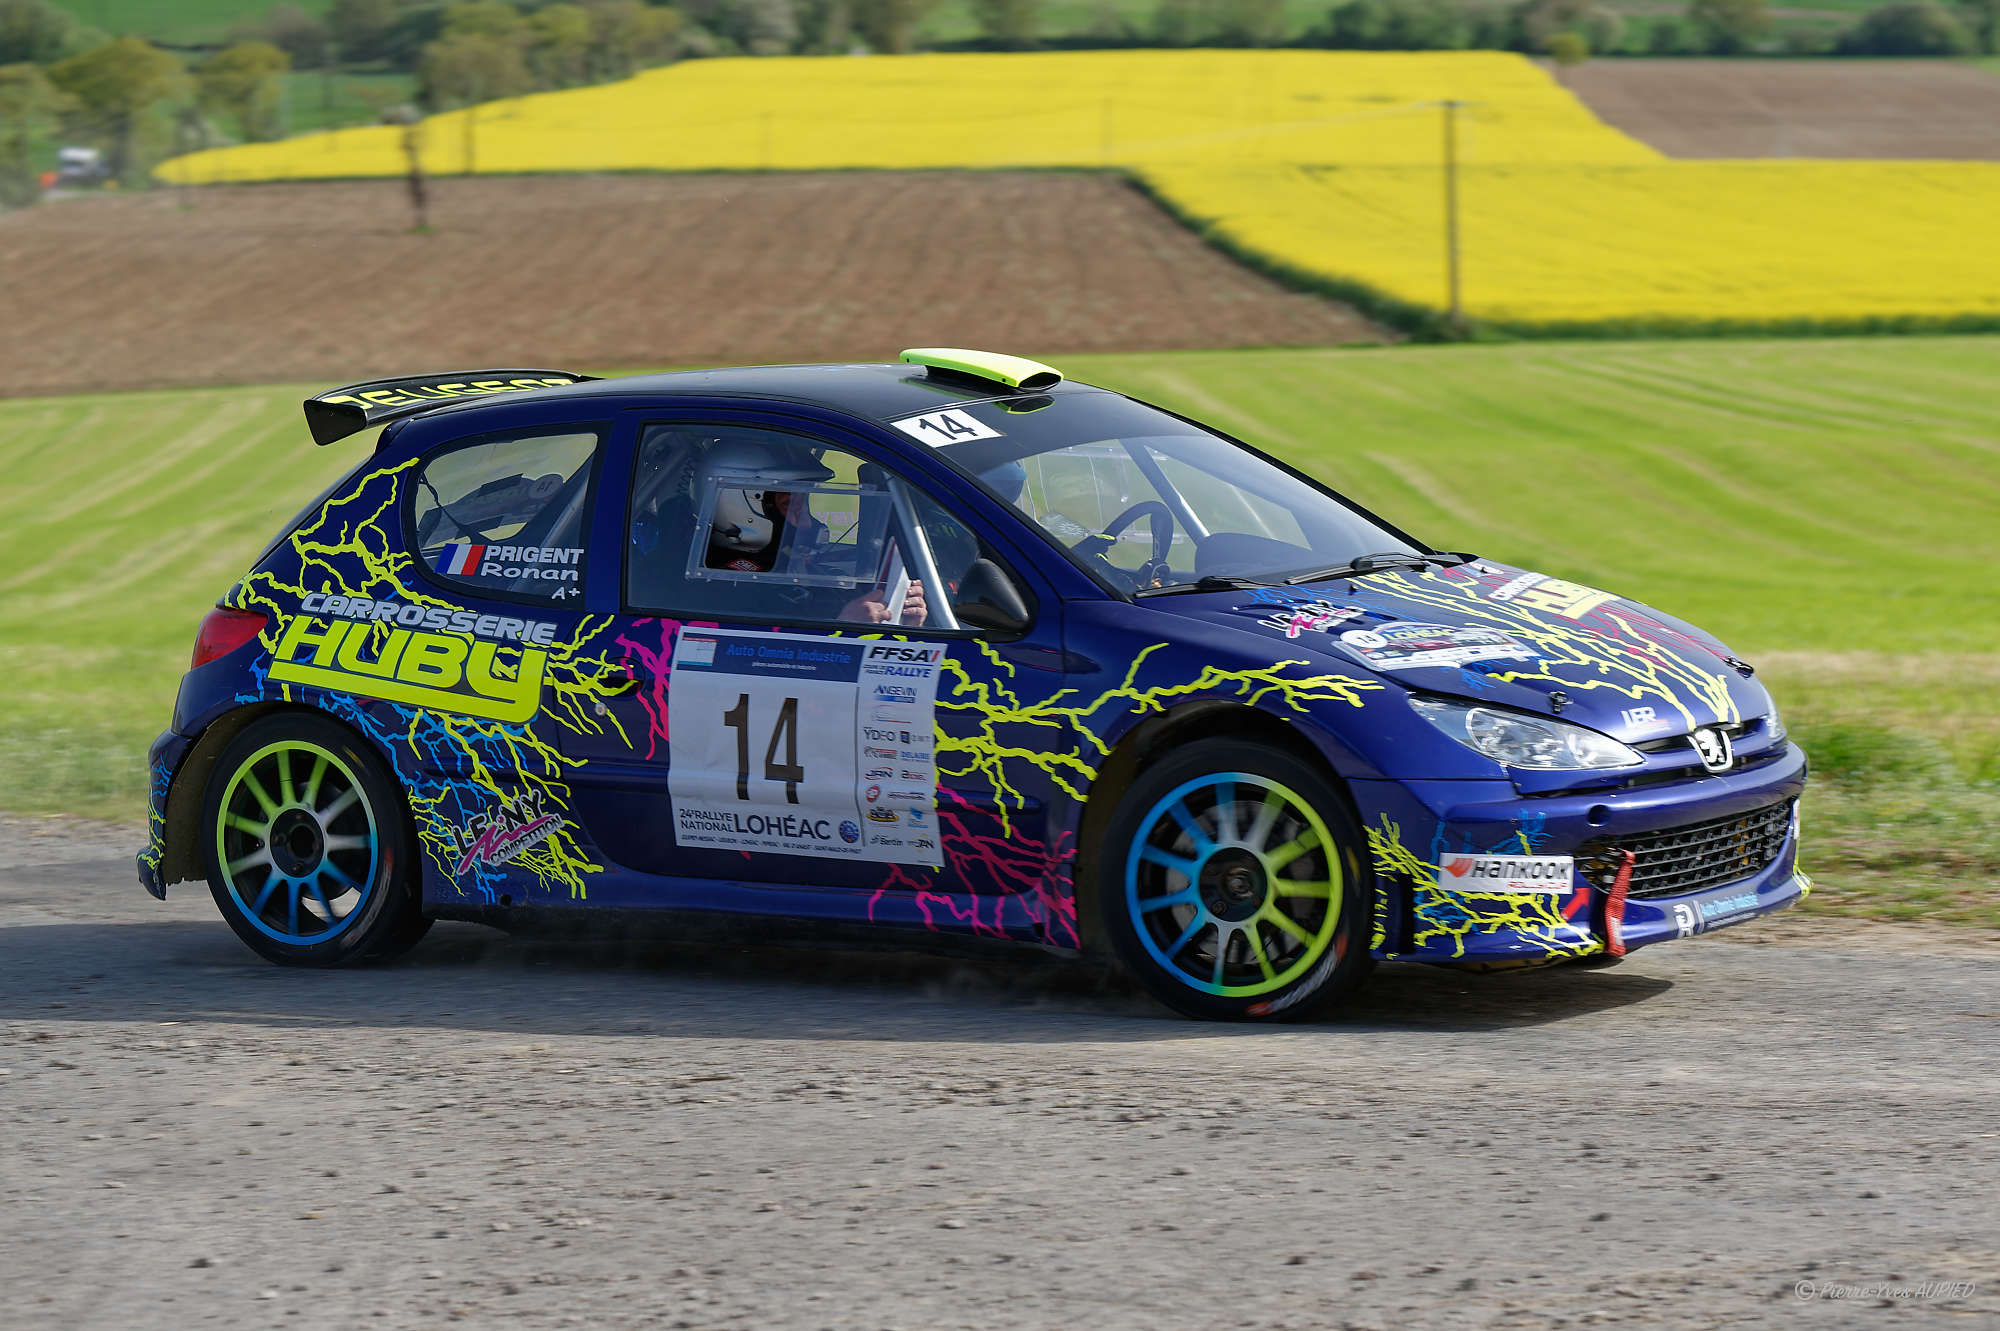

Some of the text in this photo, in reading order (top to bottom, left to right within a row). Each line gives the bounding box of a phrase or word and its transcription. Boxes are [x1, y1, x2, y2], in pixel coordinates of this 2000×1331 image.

[919, 413, 977, 441] 14
[484, 545, 585, 565] PRIGENT
[480, 562, 579, 581] Ronan
[551, 586, 581, 600] A+
[300, 592, 557, 645] CARROSSERIE
[726, 644, 851, 664] Auto Omnia Industrie
[868, 647, 929, 662] FFSA
[267, 615, 548, 724] HUBY
[884, 666, 932, 678] RALLYE
[724, 694, 804, 804] 14
[694, 810, 733, 822] RALLYE
[680, 820, 734, 833] NATIONAL
[733, 813, 831, 840] LOHÉAC
